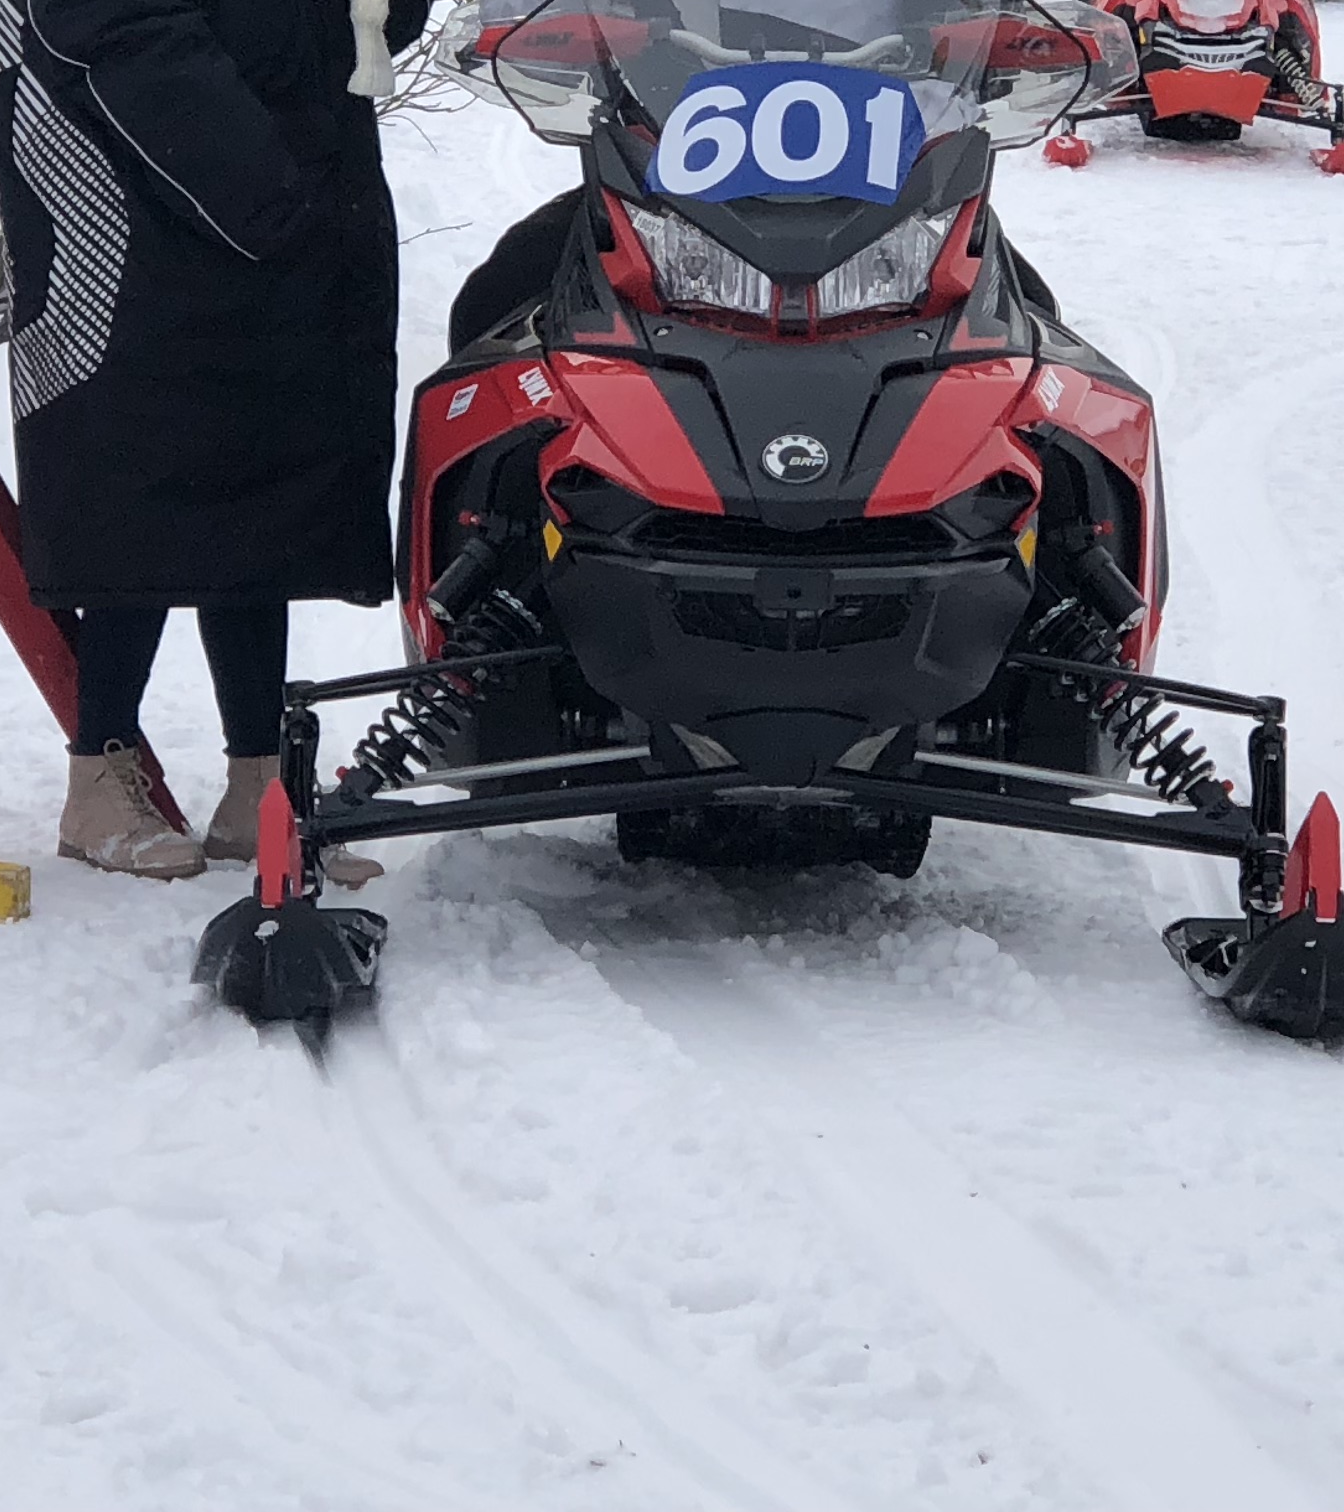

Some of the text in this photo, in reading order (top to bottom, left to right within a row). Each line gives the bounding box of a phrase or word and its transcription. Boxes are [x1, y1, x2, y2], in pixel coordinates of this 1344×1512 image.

[657, 80, 905, 195] 601
[517, 366, 554, 407] LYNX
[788, 456, 824, 467] BRP
